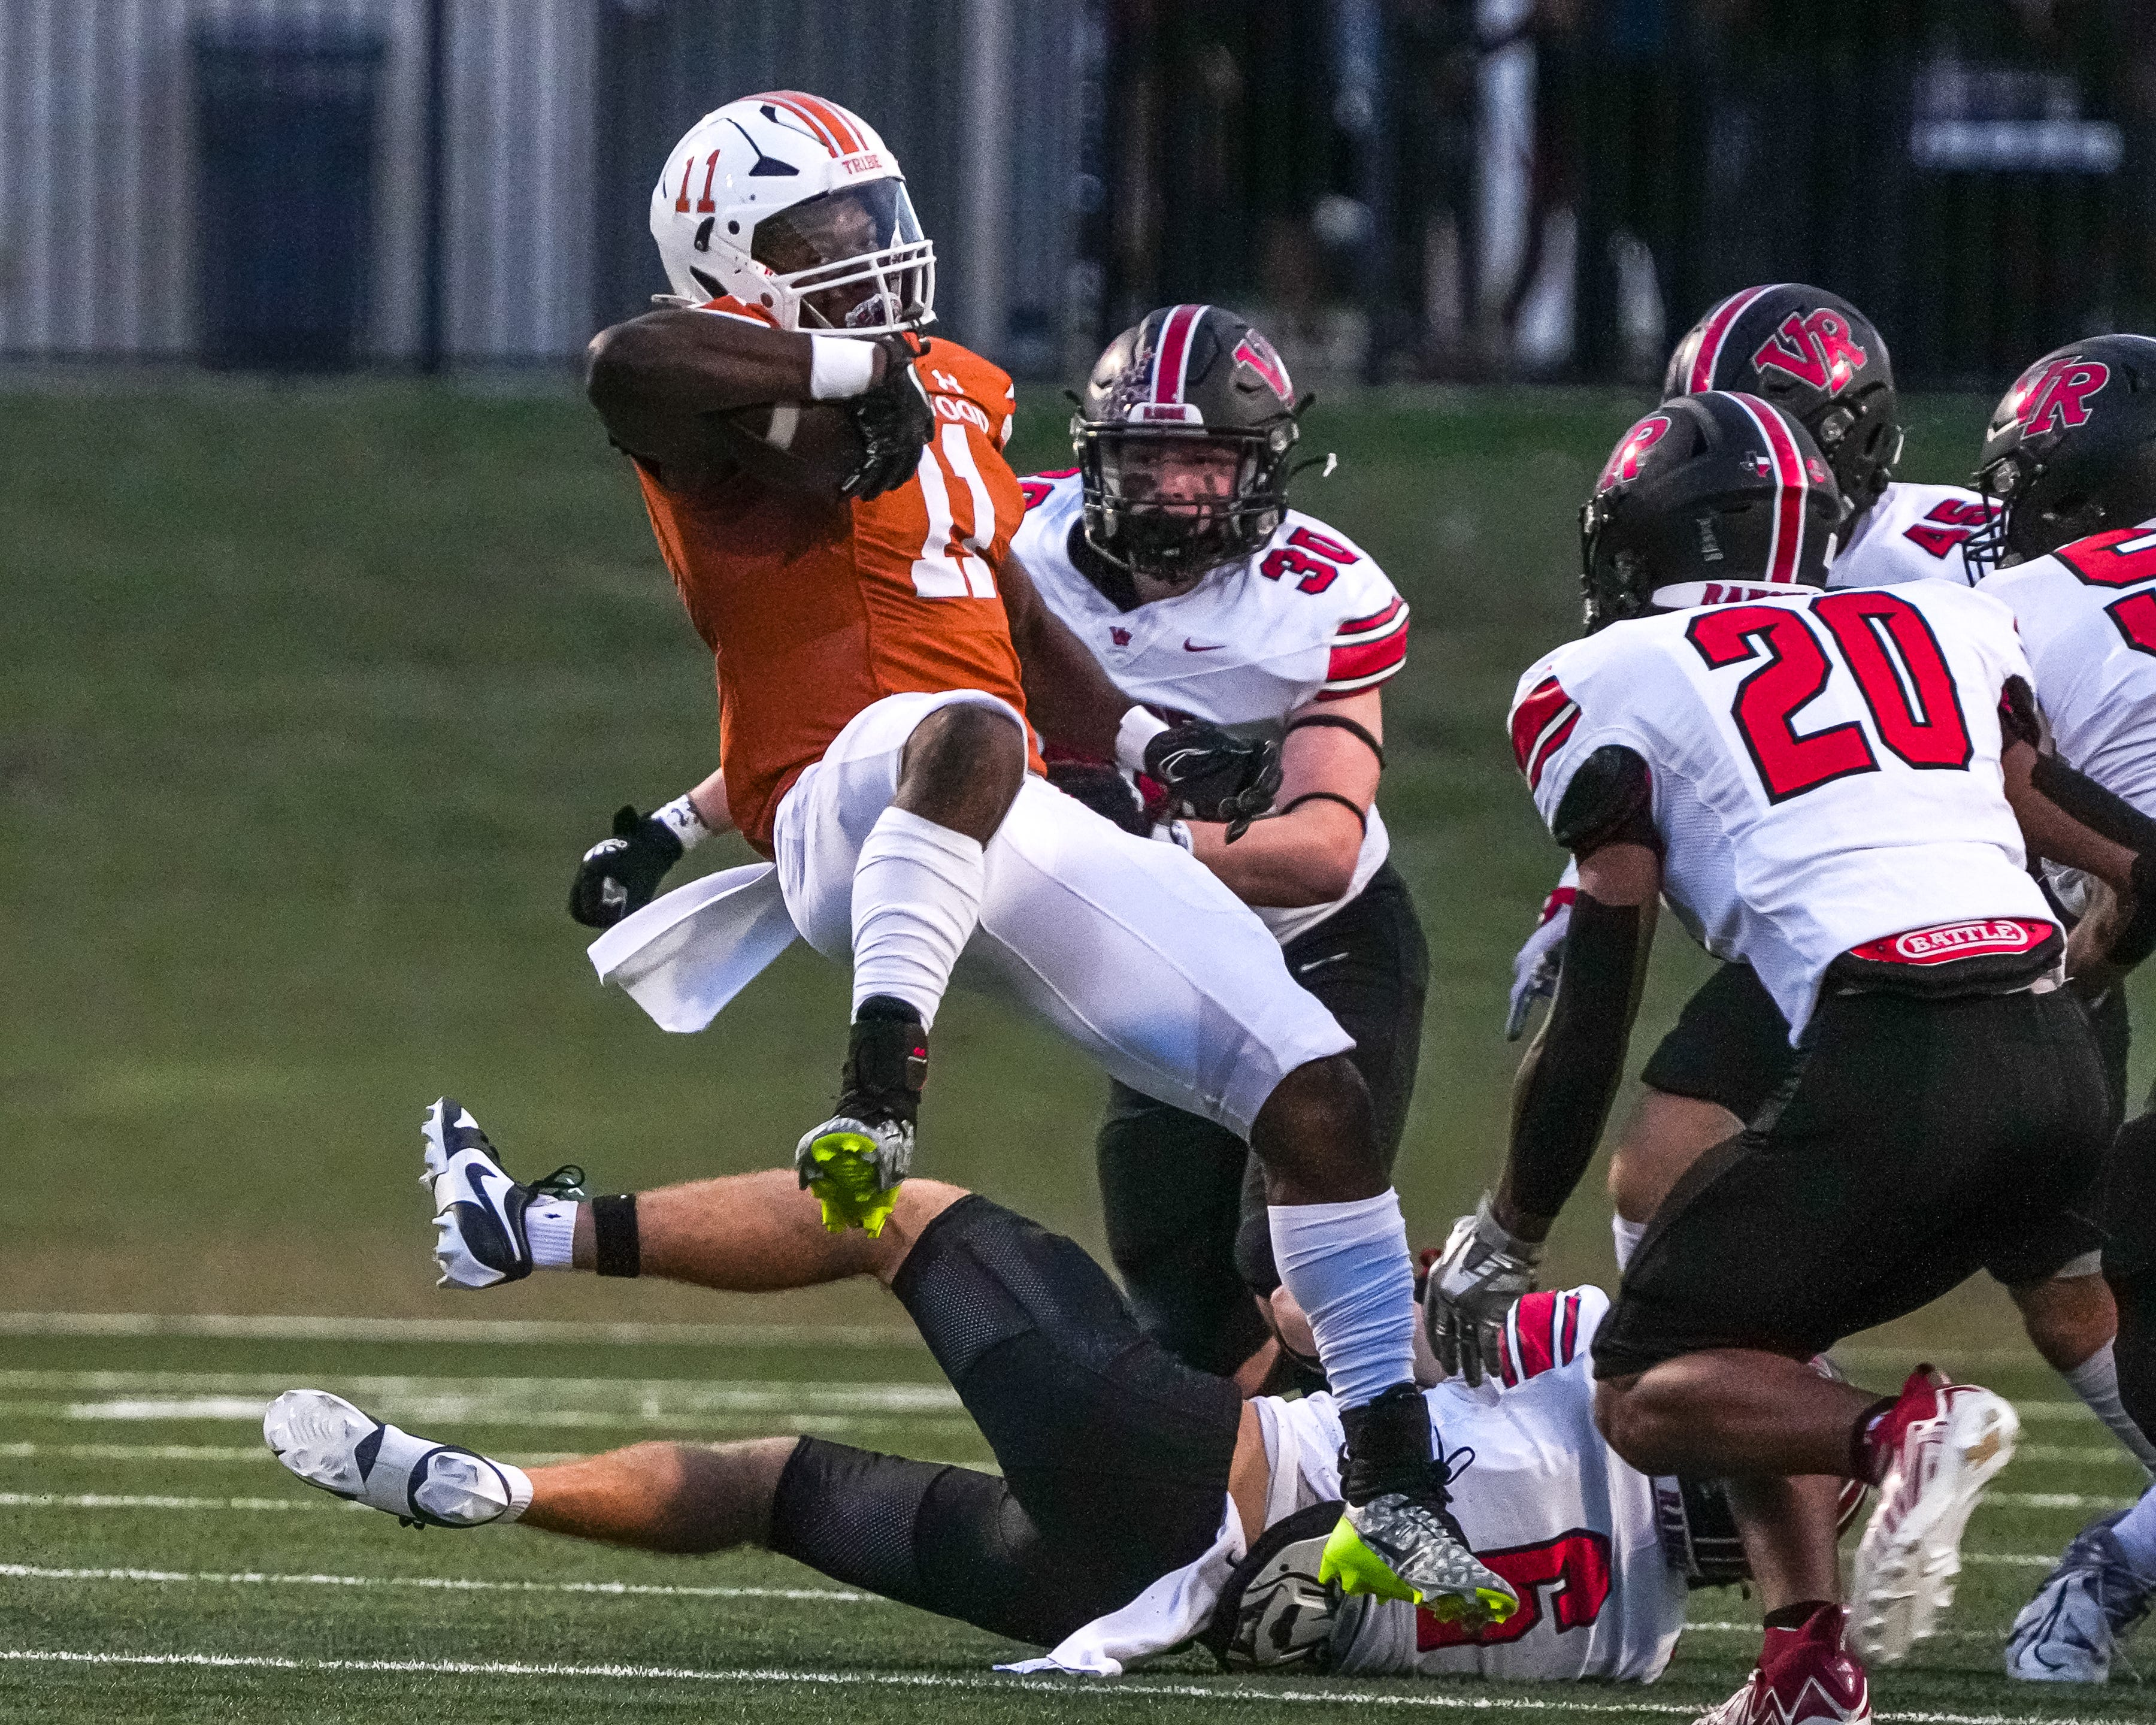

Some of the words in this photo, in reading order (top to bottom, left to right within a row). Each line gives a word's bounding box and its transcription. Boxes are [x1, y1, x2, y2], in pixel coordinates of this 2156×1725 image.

[675, 149, 720, 213] 11
[1751, 308, 1868, 398] VR
[911, 423, 998, 600] 11
[1259, 526, 1362, 595] 30
[1684, 590, 1975, 806] 20
[1908, 924, 2018, 953] BATTLE
